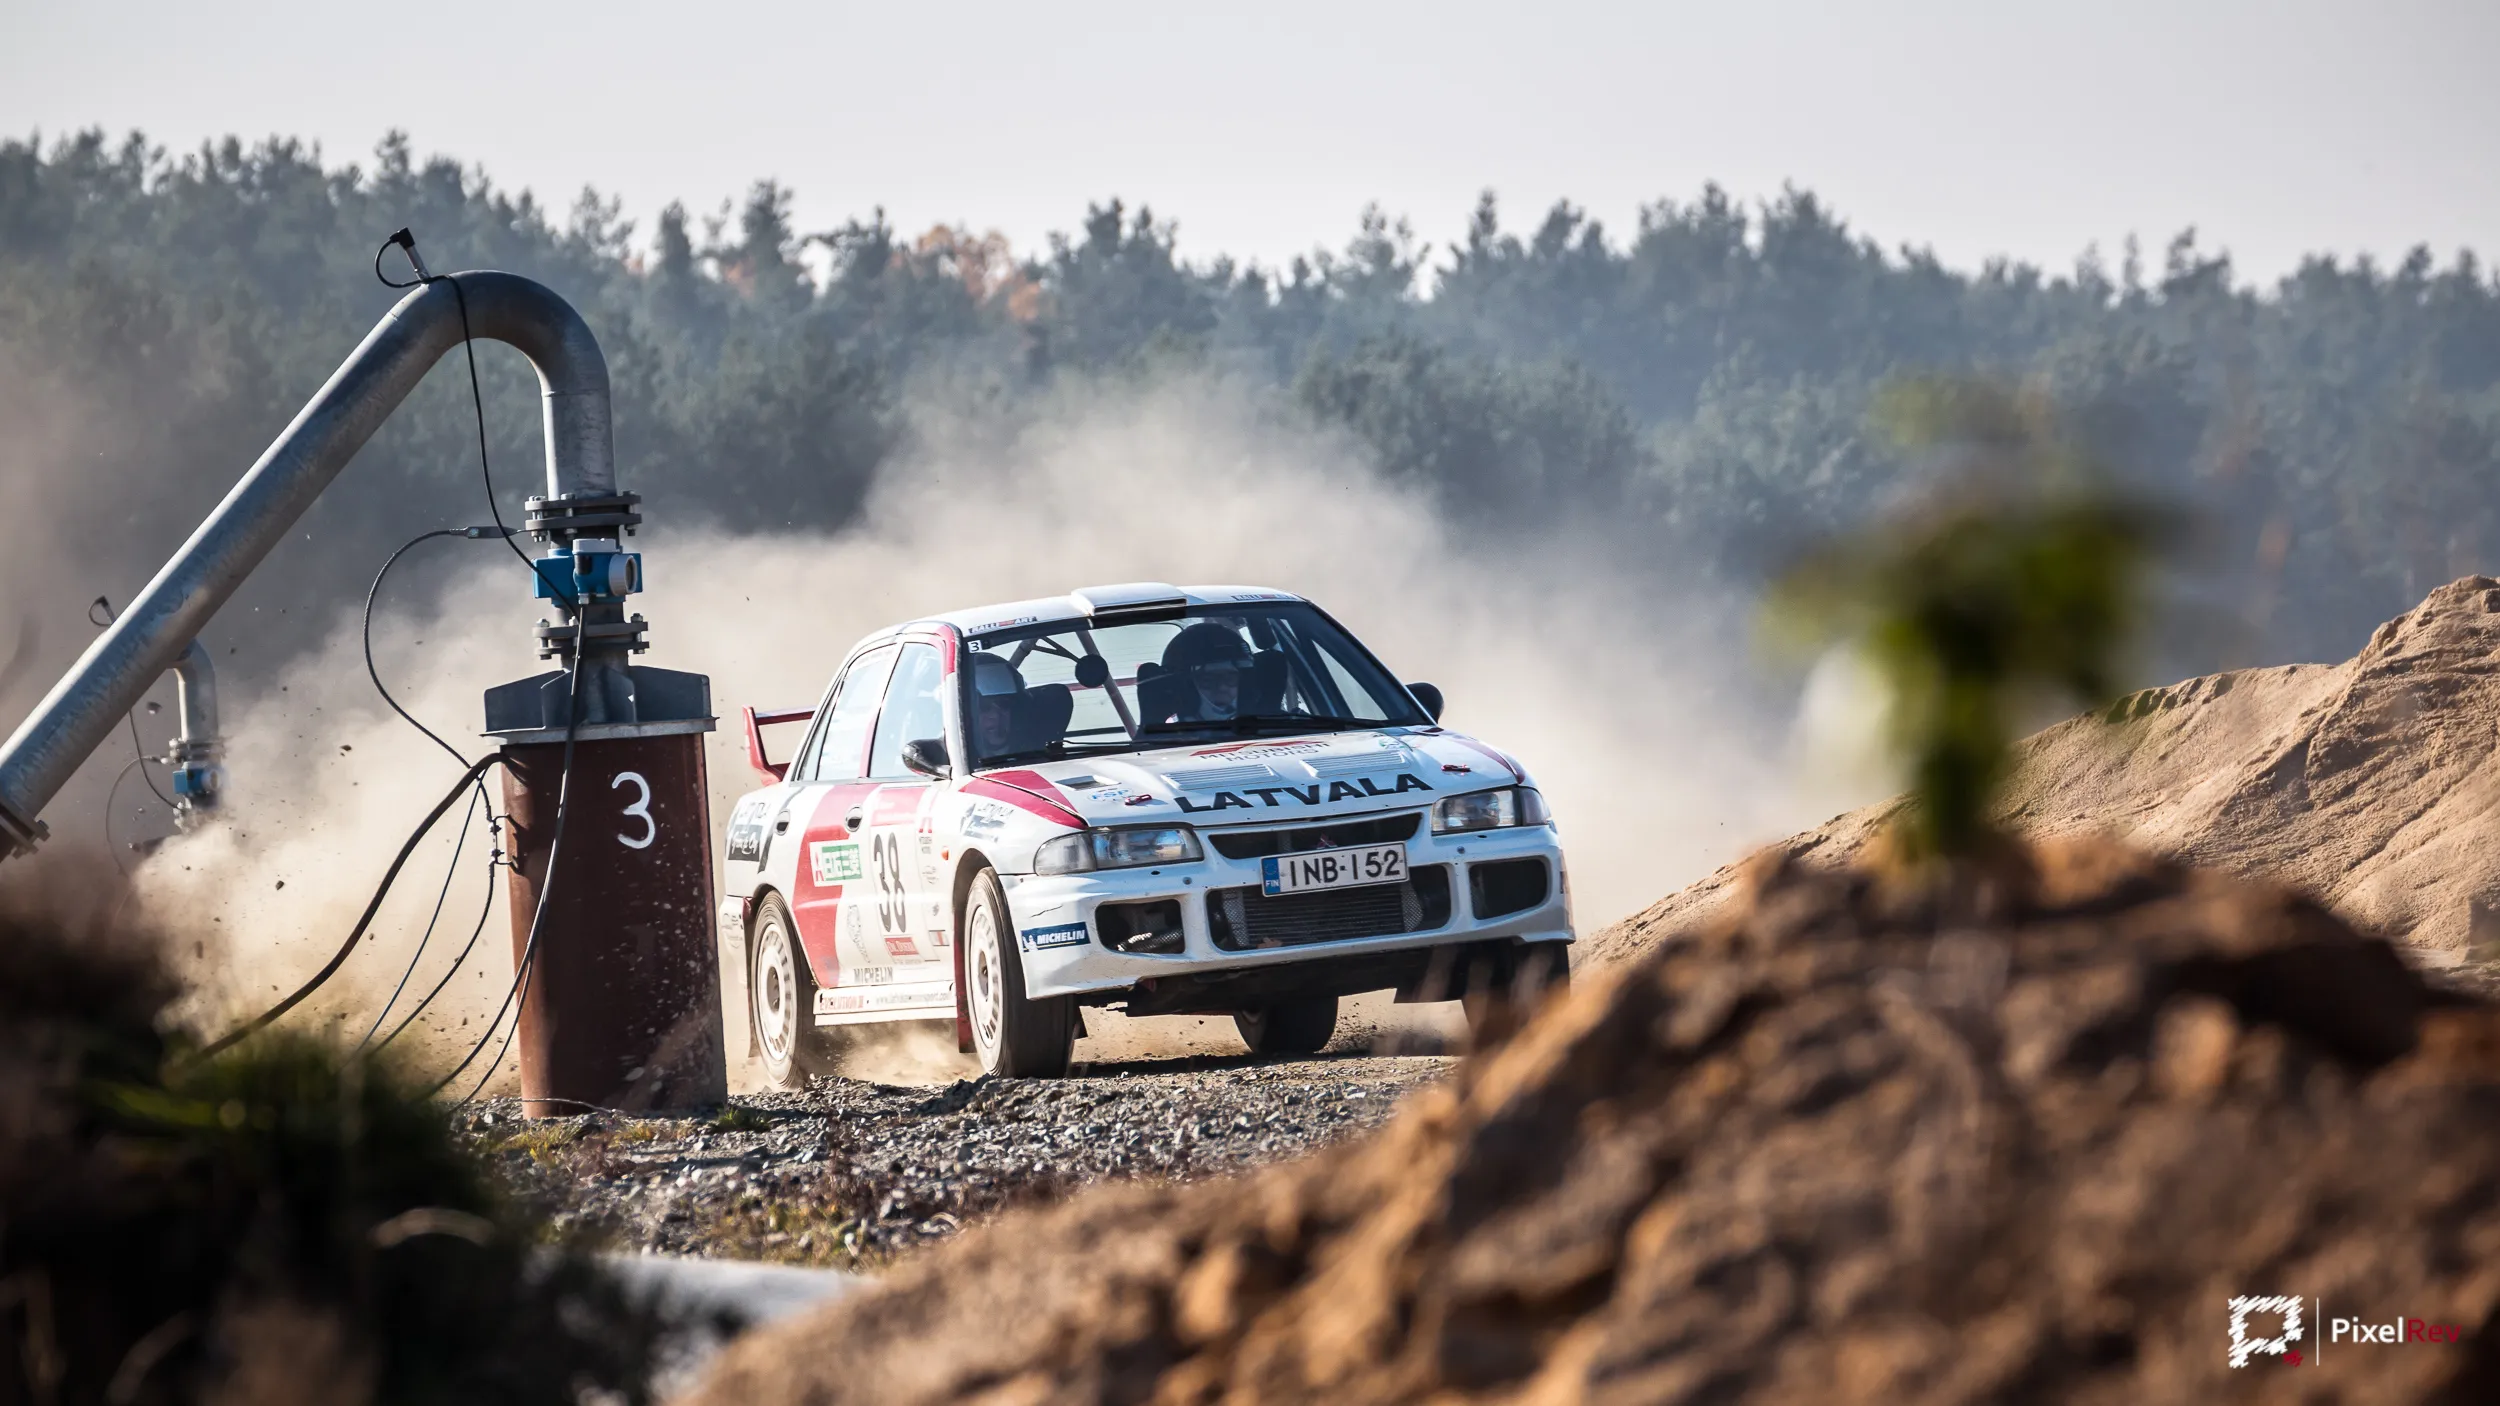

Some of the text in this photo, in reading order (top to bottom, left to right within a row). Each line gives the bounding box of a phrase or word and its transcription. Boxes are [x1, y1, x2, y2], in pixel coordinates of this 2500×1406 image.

[970, 641, 980, 652] 3
[1200, 743, 1330, 759] MITSUBISHI
[1226, 748, 1318, 762] MOTORS
[1173, 773, 1434, 814] LATVALA
[611, 771, 656, 850] 3
[1265, 849, 1400, 887] FIN INB-152
[873, 832, 907, 933] 38
[1037, 930, 1086, 944] MICHELIN
[853, 967, 893, 983] MICHELIN
